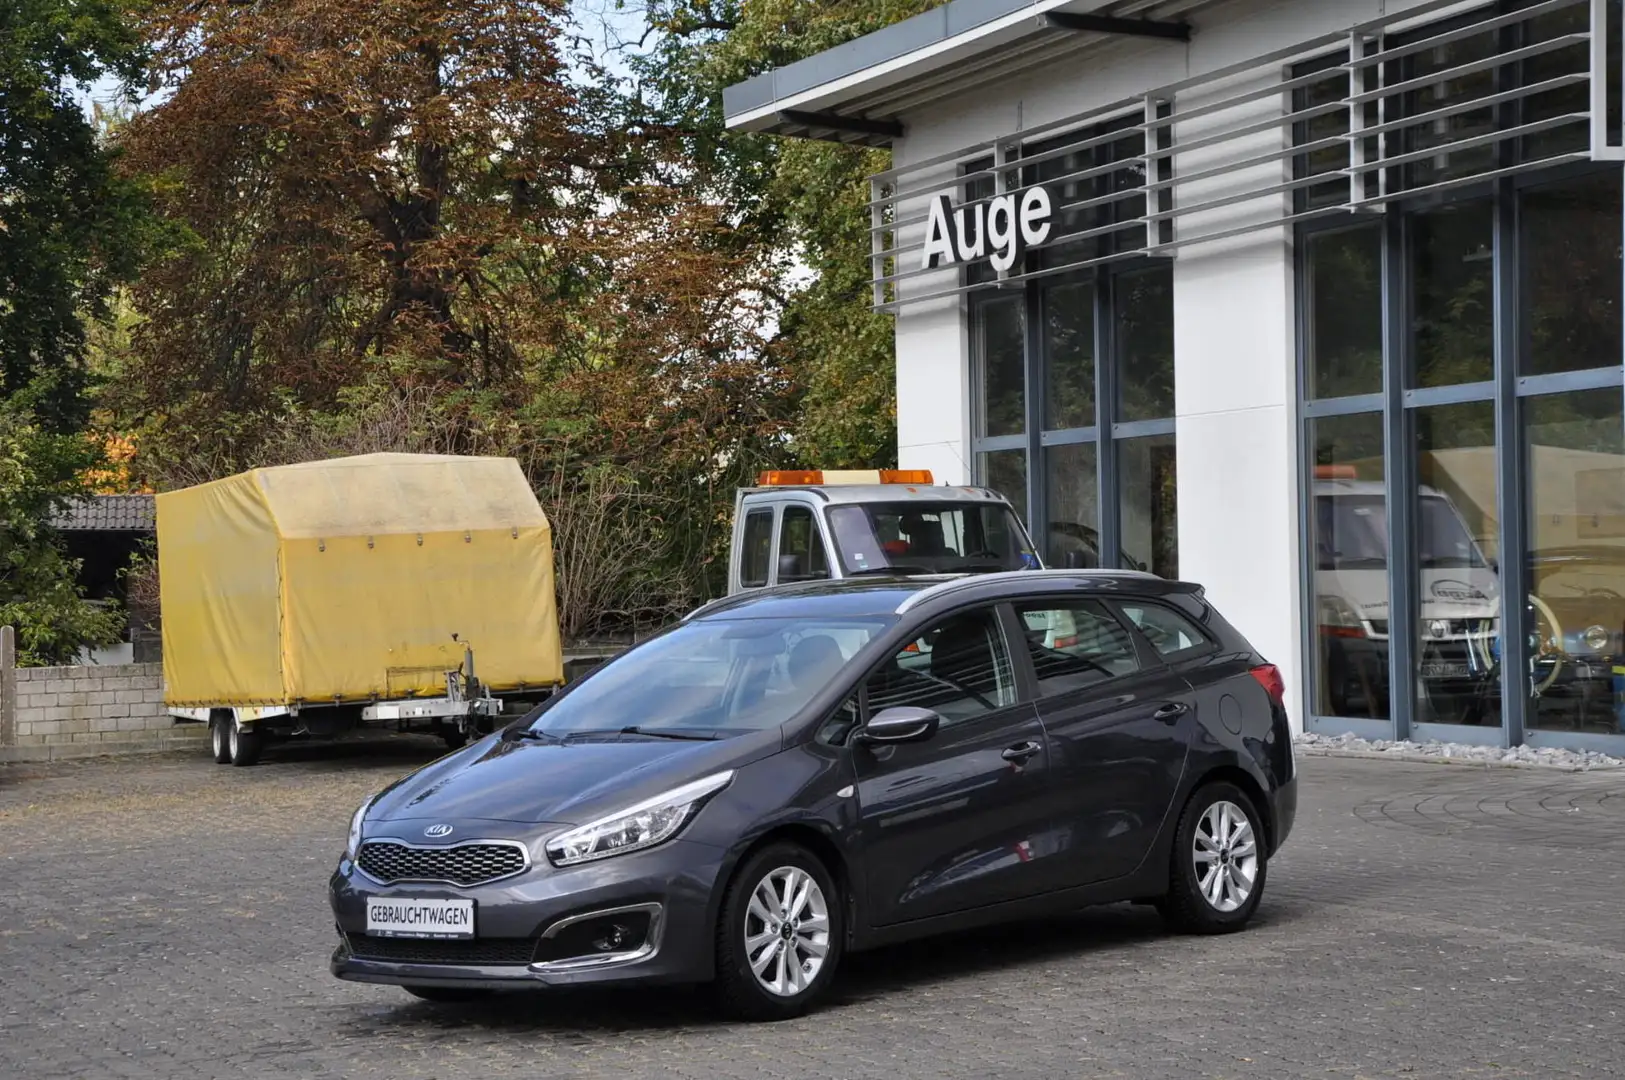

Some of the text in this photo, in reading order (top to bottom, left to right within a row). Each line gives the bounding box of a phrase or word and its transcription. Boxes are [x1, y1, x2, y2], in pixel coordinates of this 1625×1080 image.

[922, 186, 1052, 272] Auge
[425, 824, 449, 835] KIA
[370, 905, 469, 925] GEBRAUCHTWAGEN
